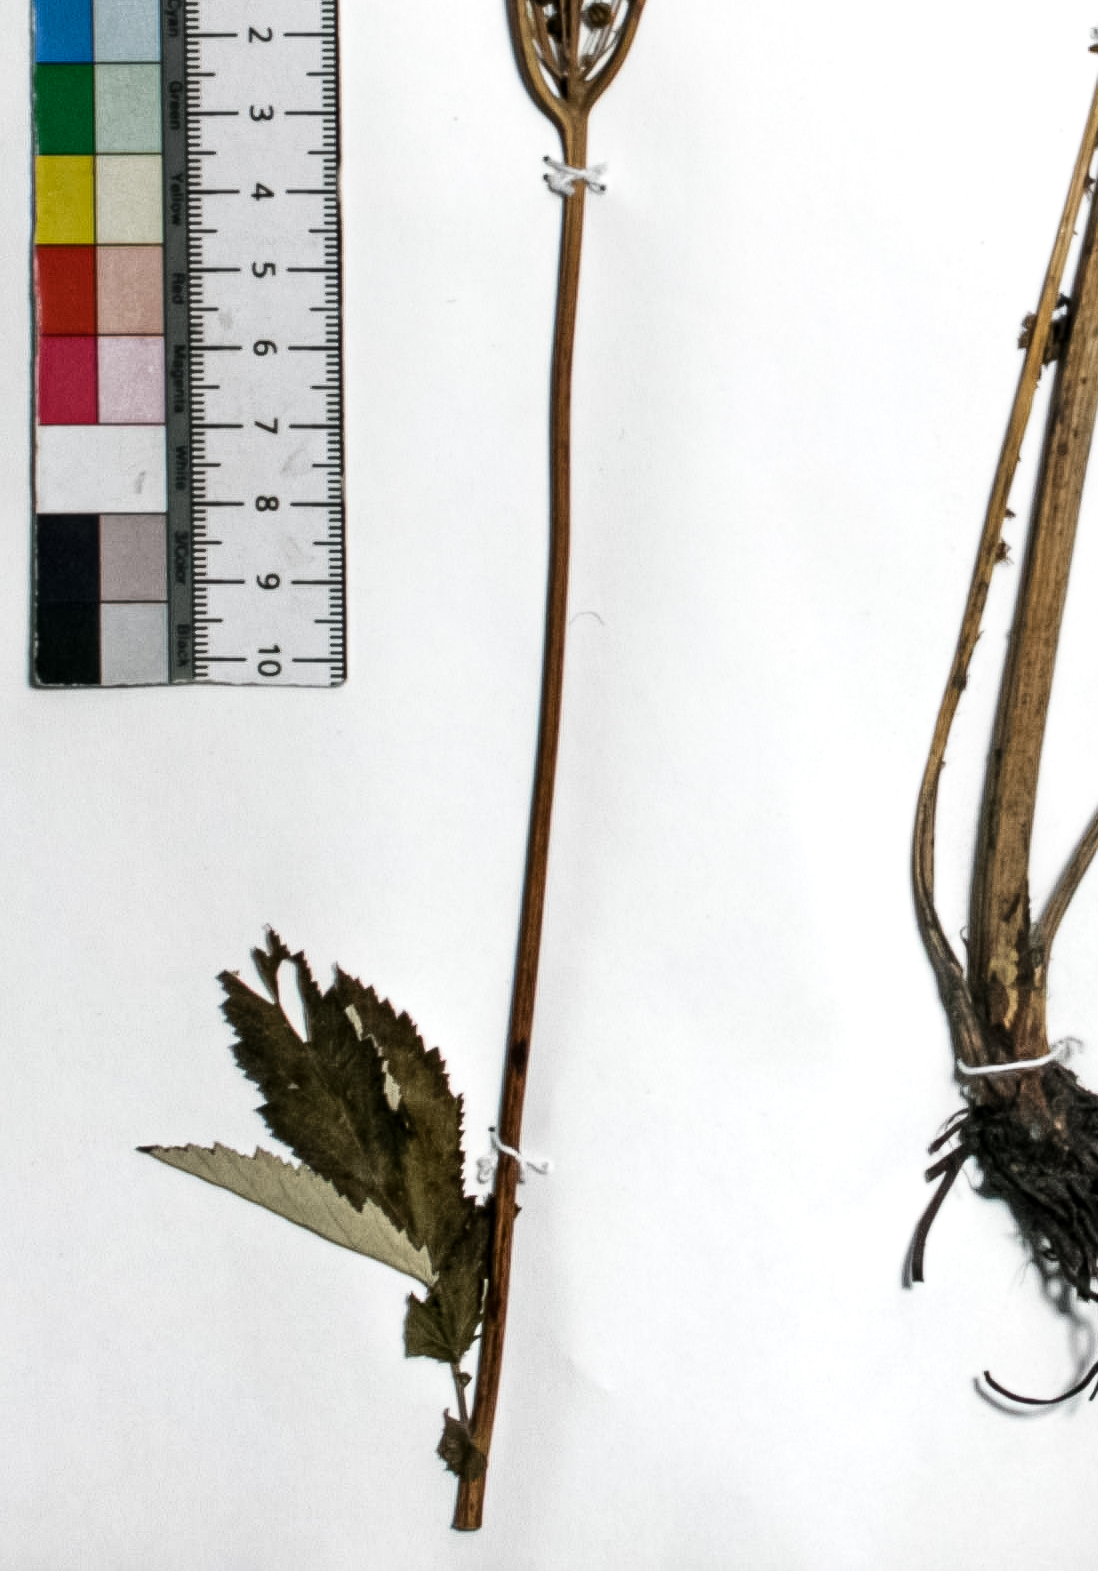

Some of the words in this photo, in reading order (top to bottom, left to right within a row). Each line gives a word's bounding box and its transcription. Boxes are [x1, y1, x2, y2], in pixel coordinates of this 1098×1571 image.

[248, 26, 273, 44] 2
[168, 80, 182, 130] Green
[250, 104, 274, 122] 3
[169, 173, 183, 227] Yellow
[251, 182, 275, 201] 4
[252, 261, 276, 278] 5
[171, 272, 186, 306] Red
[253, 339, 277, 356] 6
[172, 344, 187, 414] Magenta
[254, 417, 278, 435] 7
[175, 445, 188, 491] White
[255, 495, 280, 512] 8
[256, 573, 281, 590] 9
[176, 623, 190, 667] Black
[257, 644, 282, 677] 10
